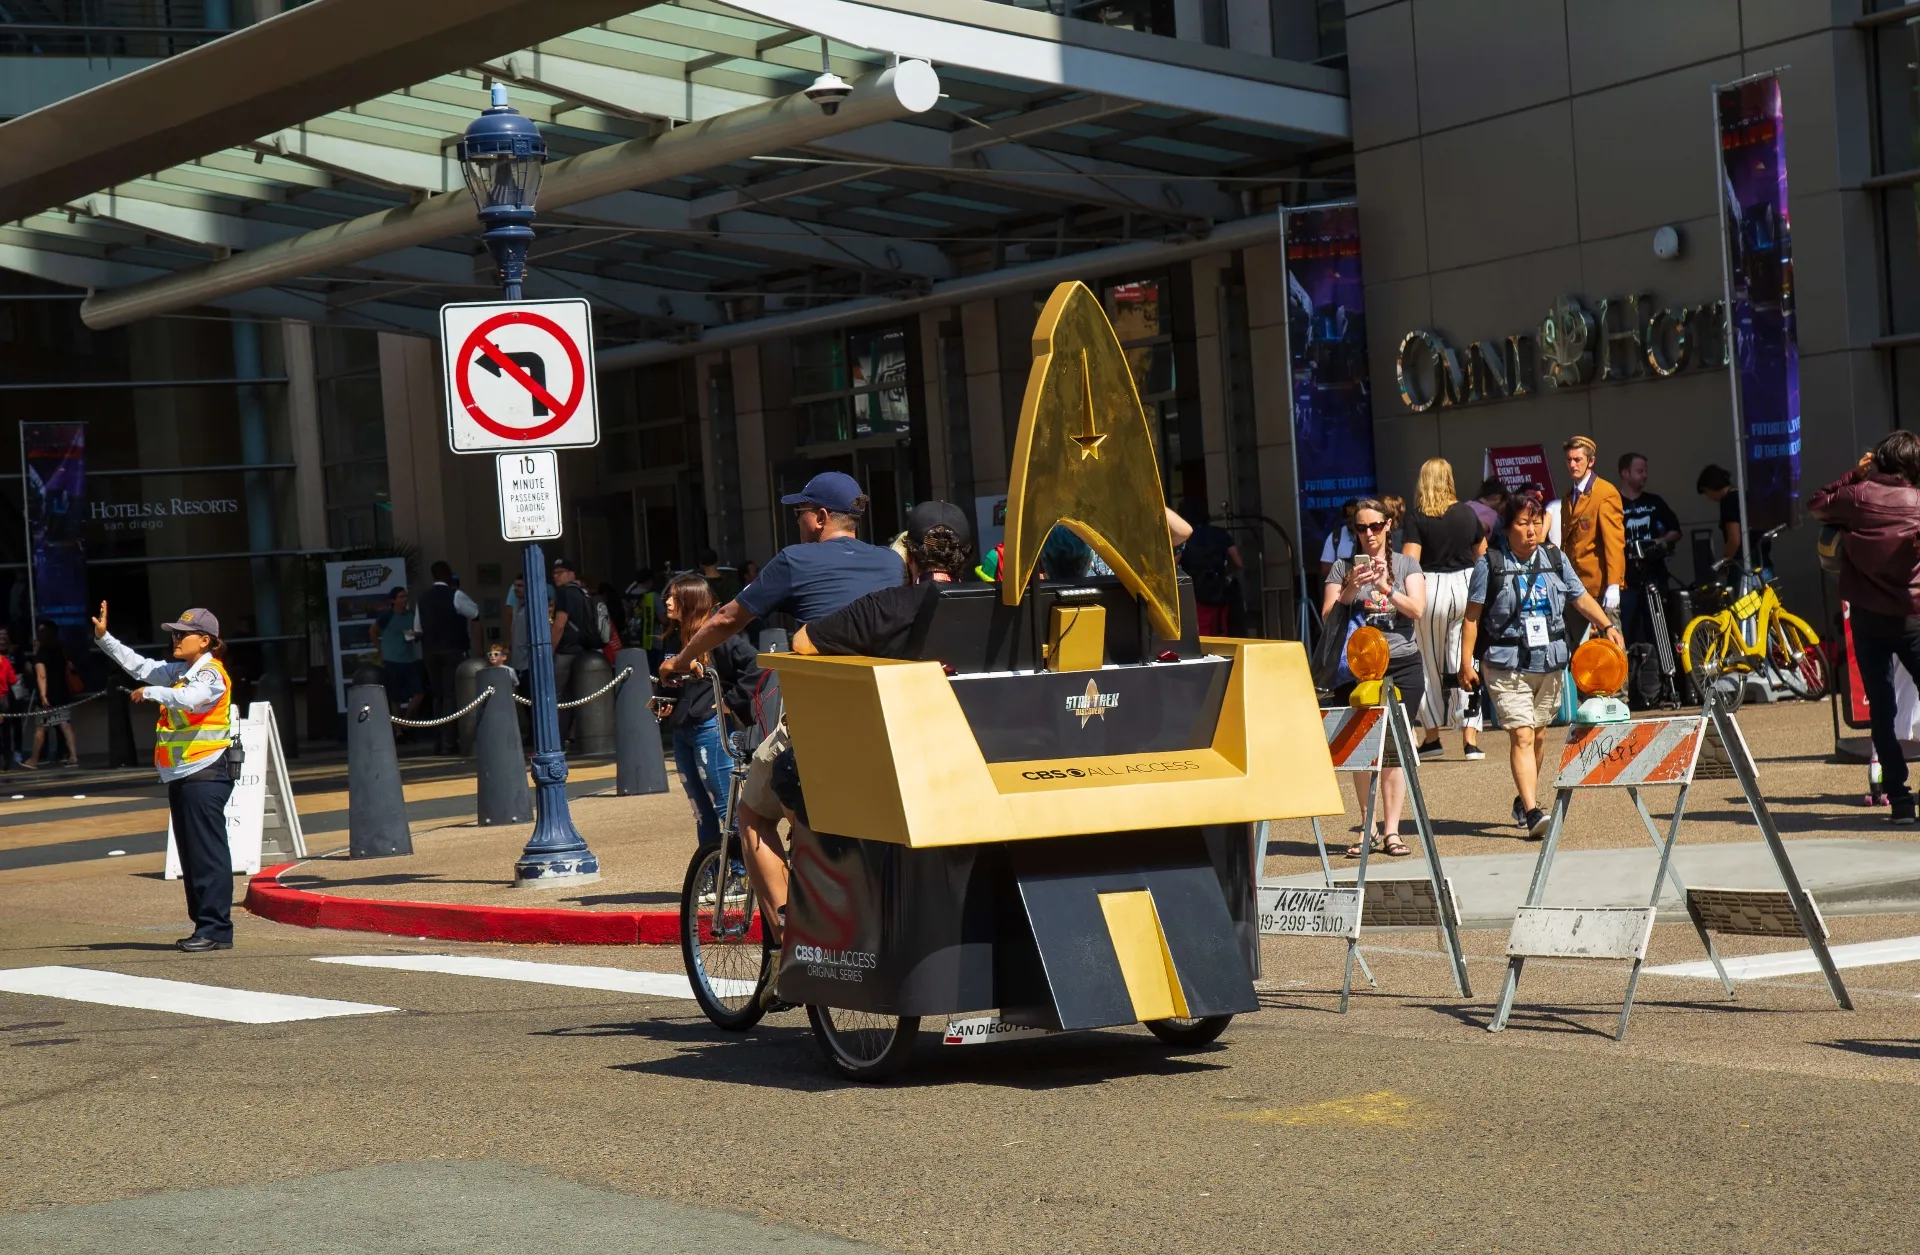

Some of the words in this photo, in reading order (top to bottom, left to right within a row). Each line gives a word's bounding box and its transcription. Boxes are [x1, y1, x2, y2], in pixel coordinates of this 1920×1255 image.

[520, 458, 535, 475] 10
[1495, 456, 1515, 467] FUTURE
[1497, 467, 1514, 476] EVENT
[1514, 466, 1521, 474] IS
[512, 477, 545, 490] MINUTE
[1525, 474, 1532, 482] AT
[1304, 479, 1337, 491] FUTURE
[510, 492, 550, 503] PASSENGER
[1316, 496, 1331, 508] THE
[90, 500, 152, 519] HOTELS
[154, 502, 168, 516] &
[170, 498, 238, 515] RESORTS
[516, 502, 546, 513] LOADING
[104, 521, 125, 531] san
[128, 518, 164, 531] diego
[526, 514, 546, 523] HOURS
[346, 568, 384, 582] PAYLOAD
[356, 577, 380, 588] TOUR
[1092, 692, 1120, 709] TREK
[1022, 769, 1067, 781] CBS
[1087, 766, 1123, 777] ALL
[1125, 760, 1200, 775] ACCESS
[1274, 890, 1329, 912] ACME
[1259, 913, 1343, 932] 19-299-5100
[795, 944, 814, 962] CBS
[822, 948, 840, 965] ALL
[840, 950, 877, 969] ACCESS
[807, 964, 839, 980] ORIGINAL
[839, 968, 863, 983] SERIES
[976, 1023, 1012, 1035] DIEGO
